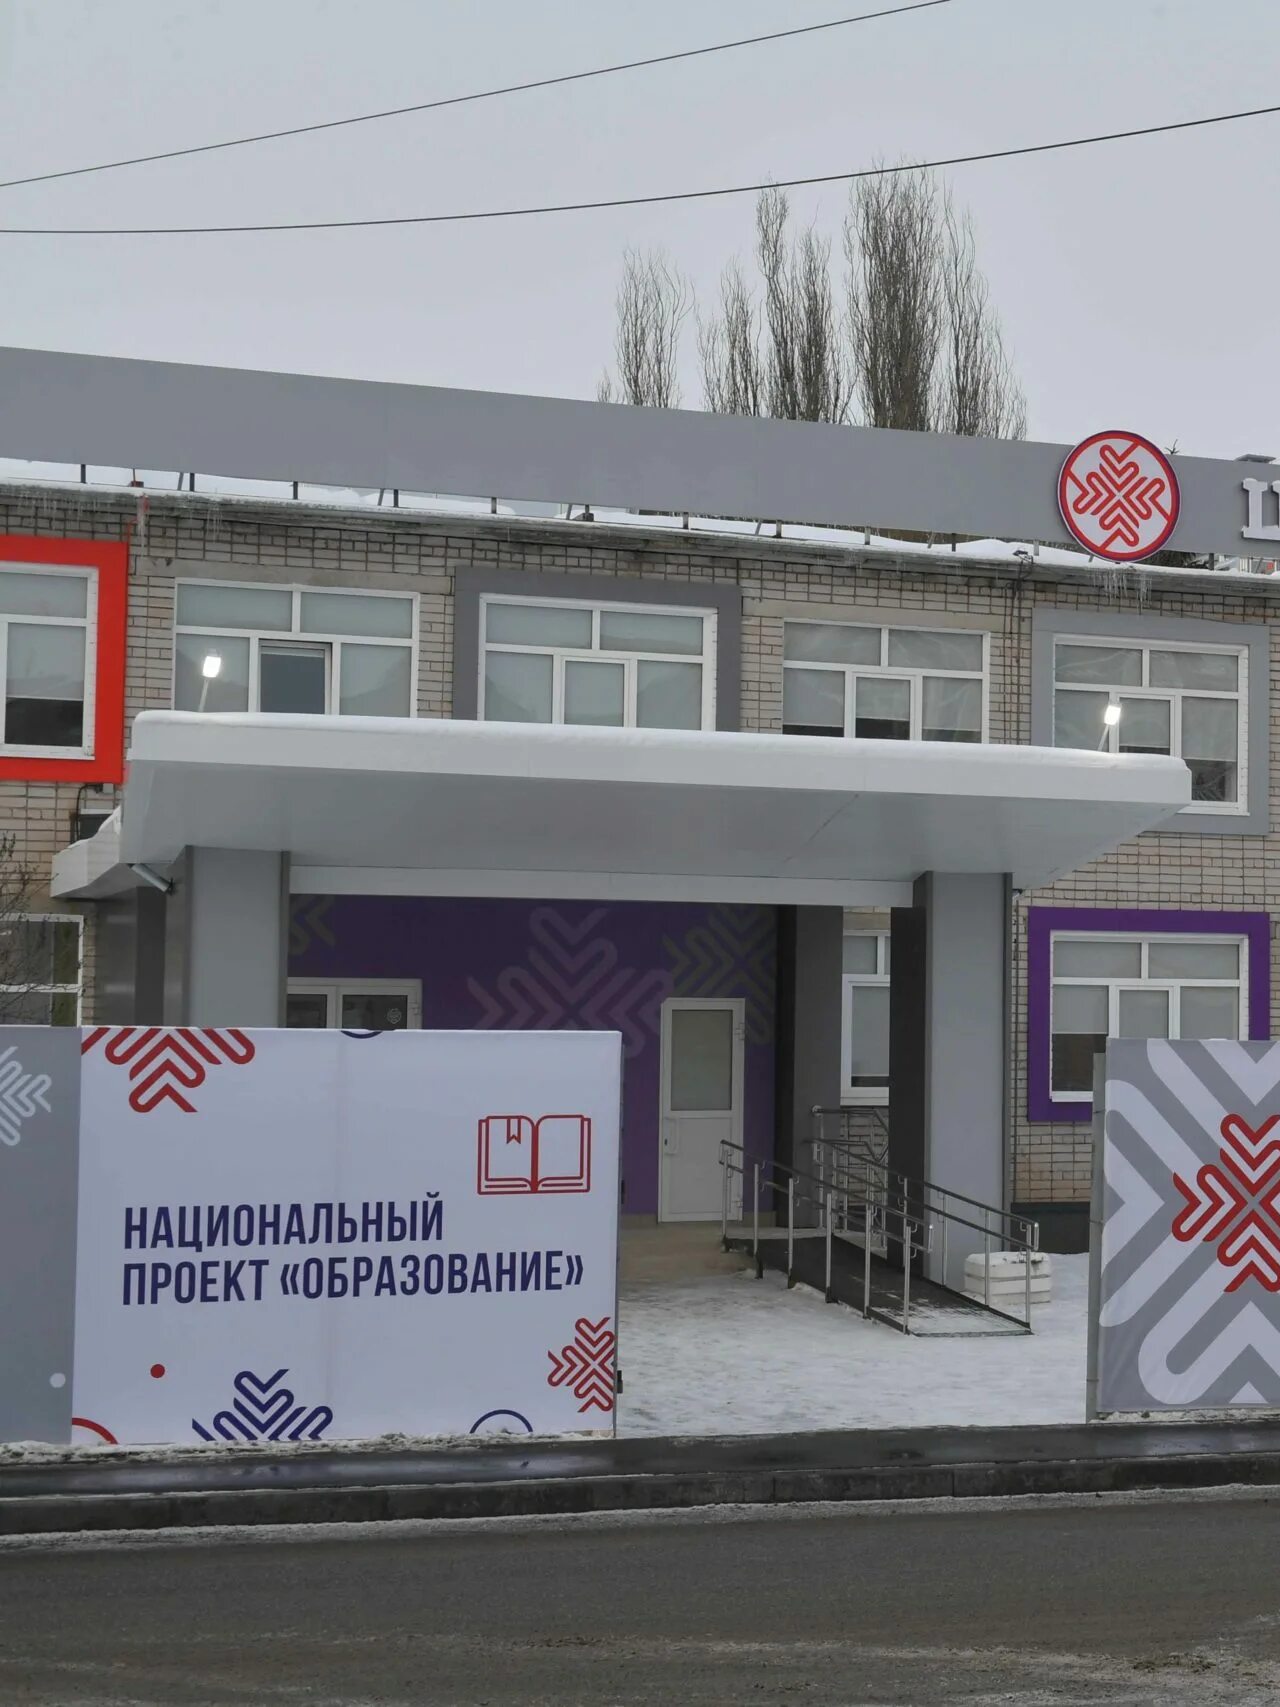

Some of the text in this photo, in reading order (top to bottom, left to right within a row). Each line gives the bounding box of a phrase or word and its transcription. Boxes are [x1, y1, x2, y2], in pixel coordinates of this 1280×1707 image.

[124, 1192, 444, 1252] НАЦИОНАЛЬНЫЙ
[123, 1250, 584, 1305] ПРОЕКТ «ОБРАЗОВАНИЕ»
